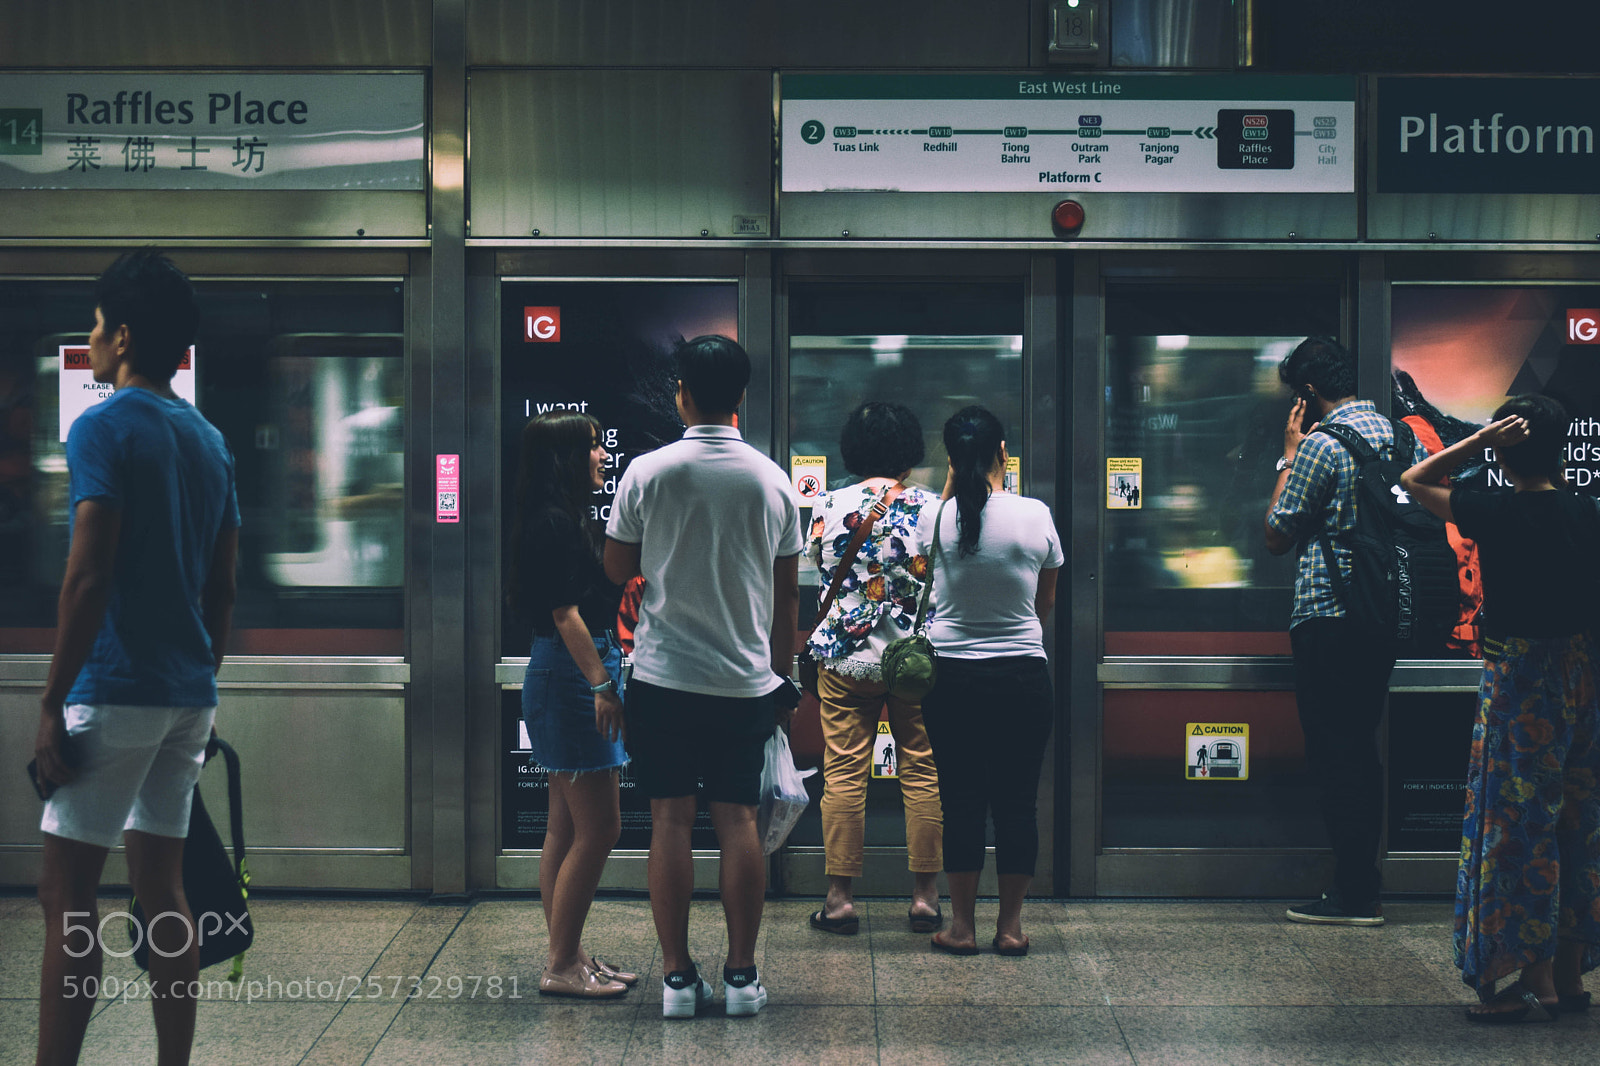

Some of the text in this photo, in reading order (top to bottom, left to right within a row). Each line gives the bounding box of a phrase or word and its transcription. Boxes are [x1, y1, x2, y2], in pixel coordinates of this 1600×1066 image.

[1065, 17, 1083, 37] 18
[1019, 81, 1121, 94] East West Line
[66, 91, 308, 125] Raffles Place
[1082, 116, 1098, 125] NE3
[1245, 117, 1265, 126] NS26
[0, 118, 39, 145] 14
[808, 125, 818, 140] 2
[834, 127, 857, 137] EW33
[930, 127, 951, 137] EW18
[1005, 127, 1026, 137] EW17
[1079, 128, 1100, 137] EW16
[1148, 128, 1170, 137] EW15
[1244, 129, 1266, 138] EW14
[1400, 112, 1594, 154] Platform
[833, 142, 880, 152] Tuas Link
[923, 142, 957, 152] Redhill
[1002, 142, 1030, 154] Tiong
[1071, 143, 1109, 153] Outram
[1139, 143, 1180, 155] Tanjong
[1239, 143, 1272, 153] Raffles
[1318, 144, 1337, 155] City
[66, 136, 269, 173] 莱佛士坊
[1001, 153, 1031, 164] Bahru
[1078, 154, 1101, 164] Park
[1145, 154, 1174, 166] Pagar
[1242, 155, 1269, 165] Place
[1318, 155, 1337, 165] Hall
[1039, 172, 1102, 183] Platform C
[527, 315, 557, 339] IG
[1568, 317, 1598, 341] IG
[525, 399, 530, 417] I
[1204, 726, 1244, 734] CAUTION
